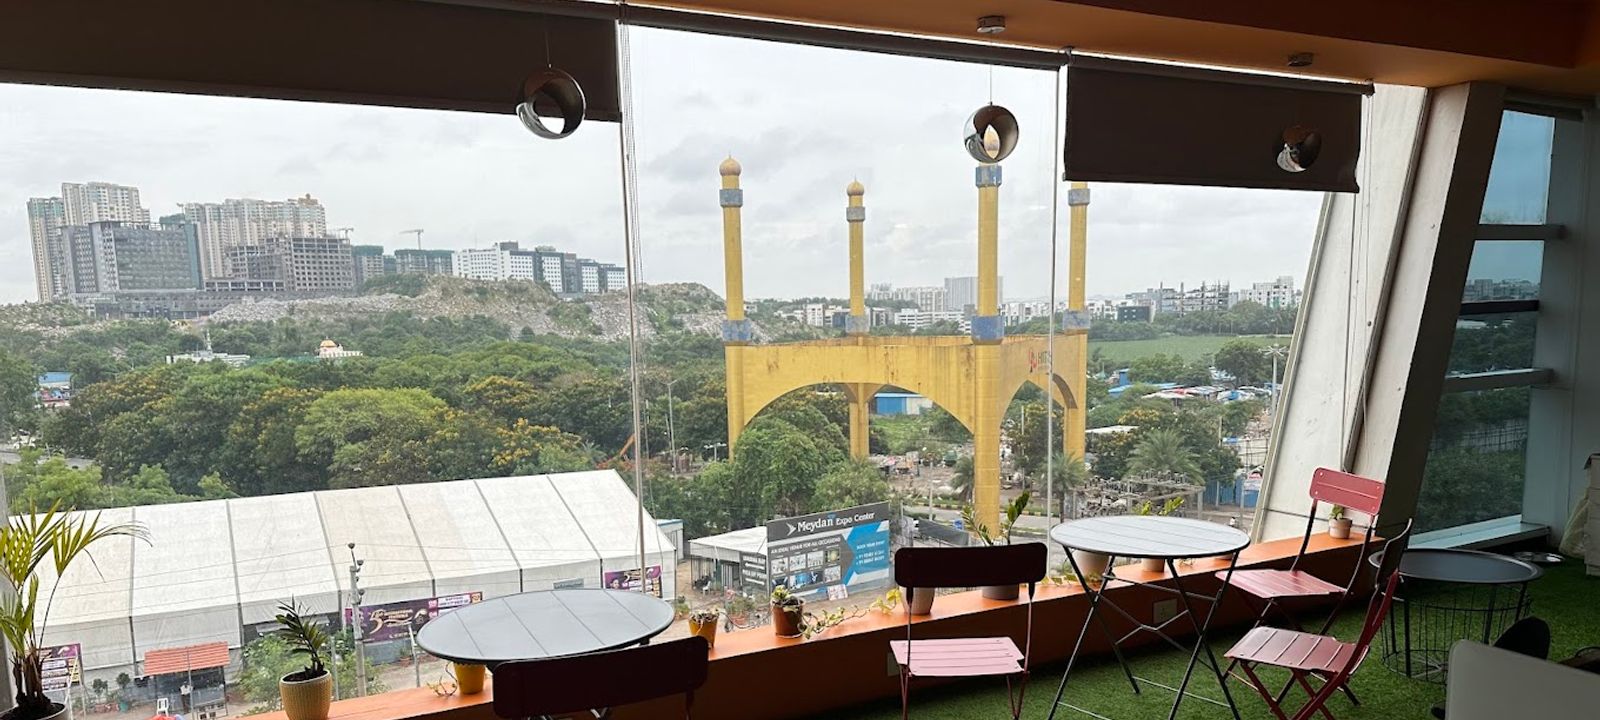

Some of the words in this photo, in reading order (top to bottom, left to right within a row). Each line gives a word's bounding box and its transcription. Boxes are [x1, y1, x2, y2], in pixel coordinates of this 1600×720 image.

[797, 518, 833, 532] Meydan
[836, 517, 853, 526] Expo
[854, 512, 875, 522] Center
